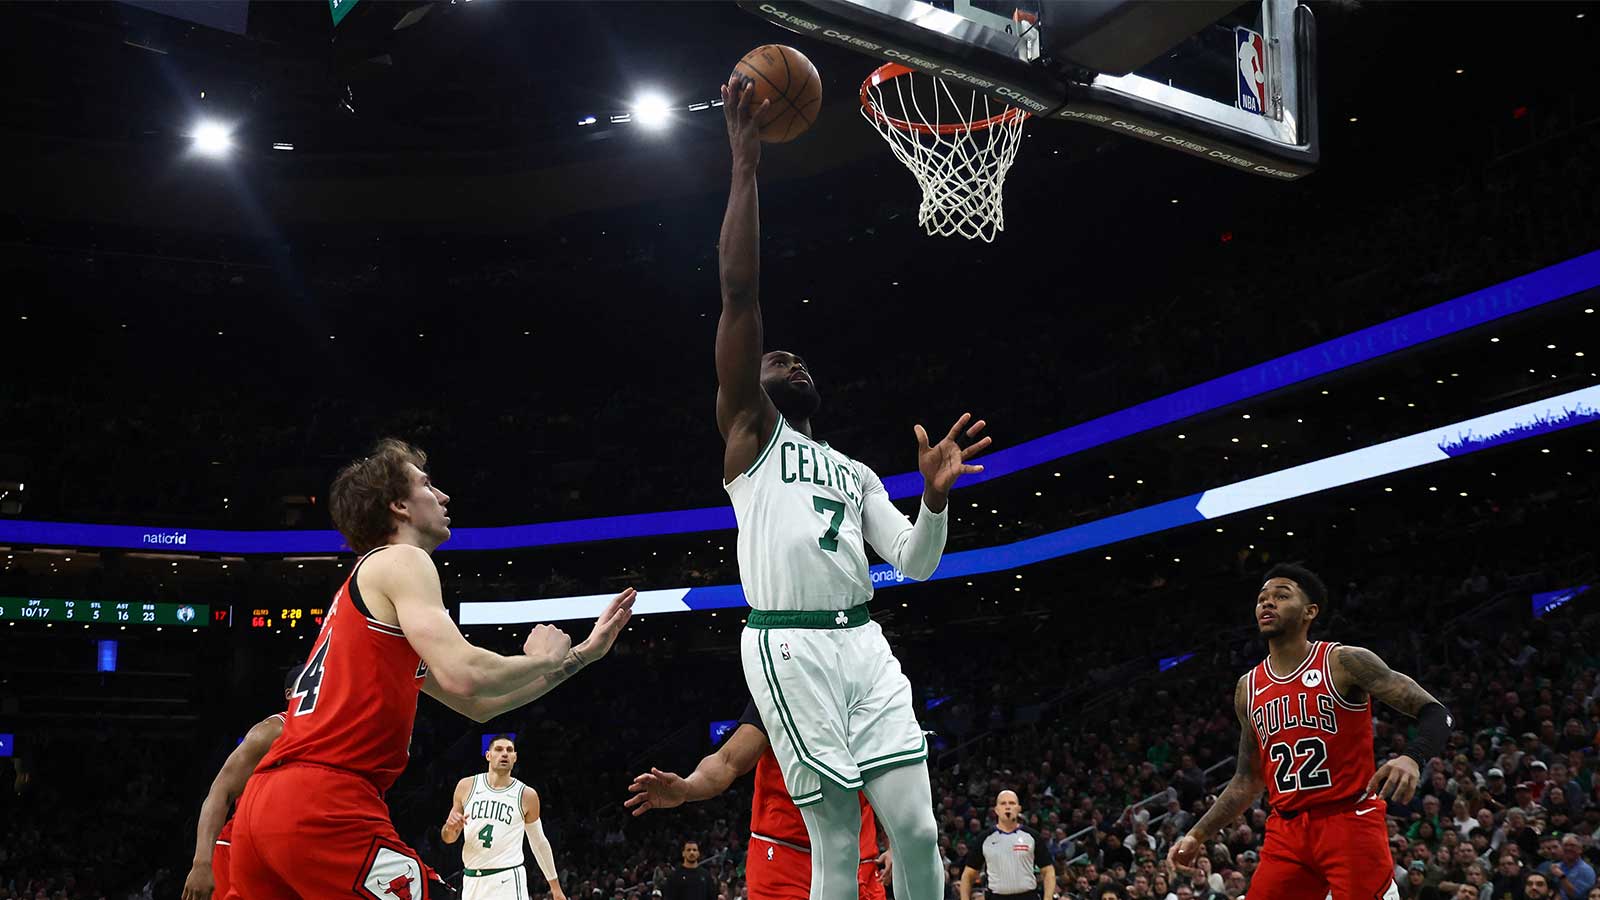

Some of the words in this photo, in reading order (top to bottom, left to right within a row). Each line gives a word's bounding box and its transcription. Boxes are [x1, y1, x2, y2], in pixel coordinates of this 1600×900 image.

[760, 4, 789, 19] C4
[786, 15, 821, 31] ENERGY
[823, 29, 851, 41] C4
[848, 37, 881, 50] ENERGY
[883, 49, 911, 60] C4
[908, 56, 940, 70] ENERGY
[941, 68, 966, 79] C4
[963, 75, 996, 89] ENERGY
[995, 86, 1021, 100] C4
[1018, 95, 1048, 112] ENERGY
[1242, 93, 1257, 112] NBA
[781, 441, 862, 513] CELTICS
[812, 494, 846, 552] 7
[21, 607, 50, 617] 10/17
[66, 608, 74, 619] 5
[92, 610, 100, 620] 5
[118, 611, 129, 621] 16
[142, 612, 155, 622] 23
[215, 611, 227, 620] 17
[252, 617, 264, 627] 66
[292, 626, 333, 717] 4
[1252, 692, 1338, 751] BULLS
[1269, 736, 1333, 794] 22
[471, 799, 514, 825] CELTICS
[478, 823, 494, 849] 4
